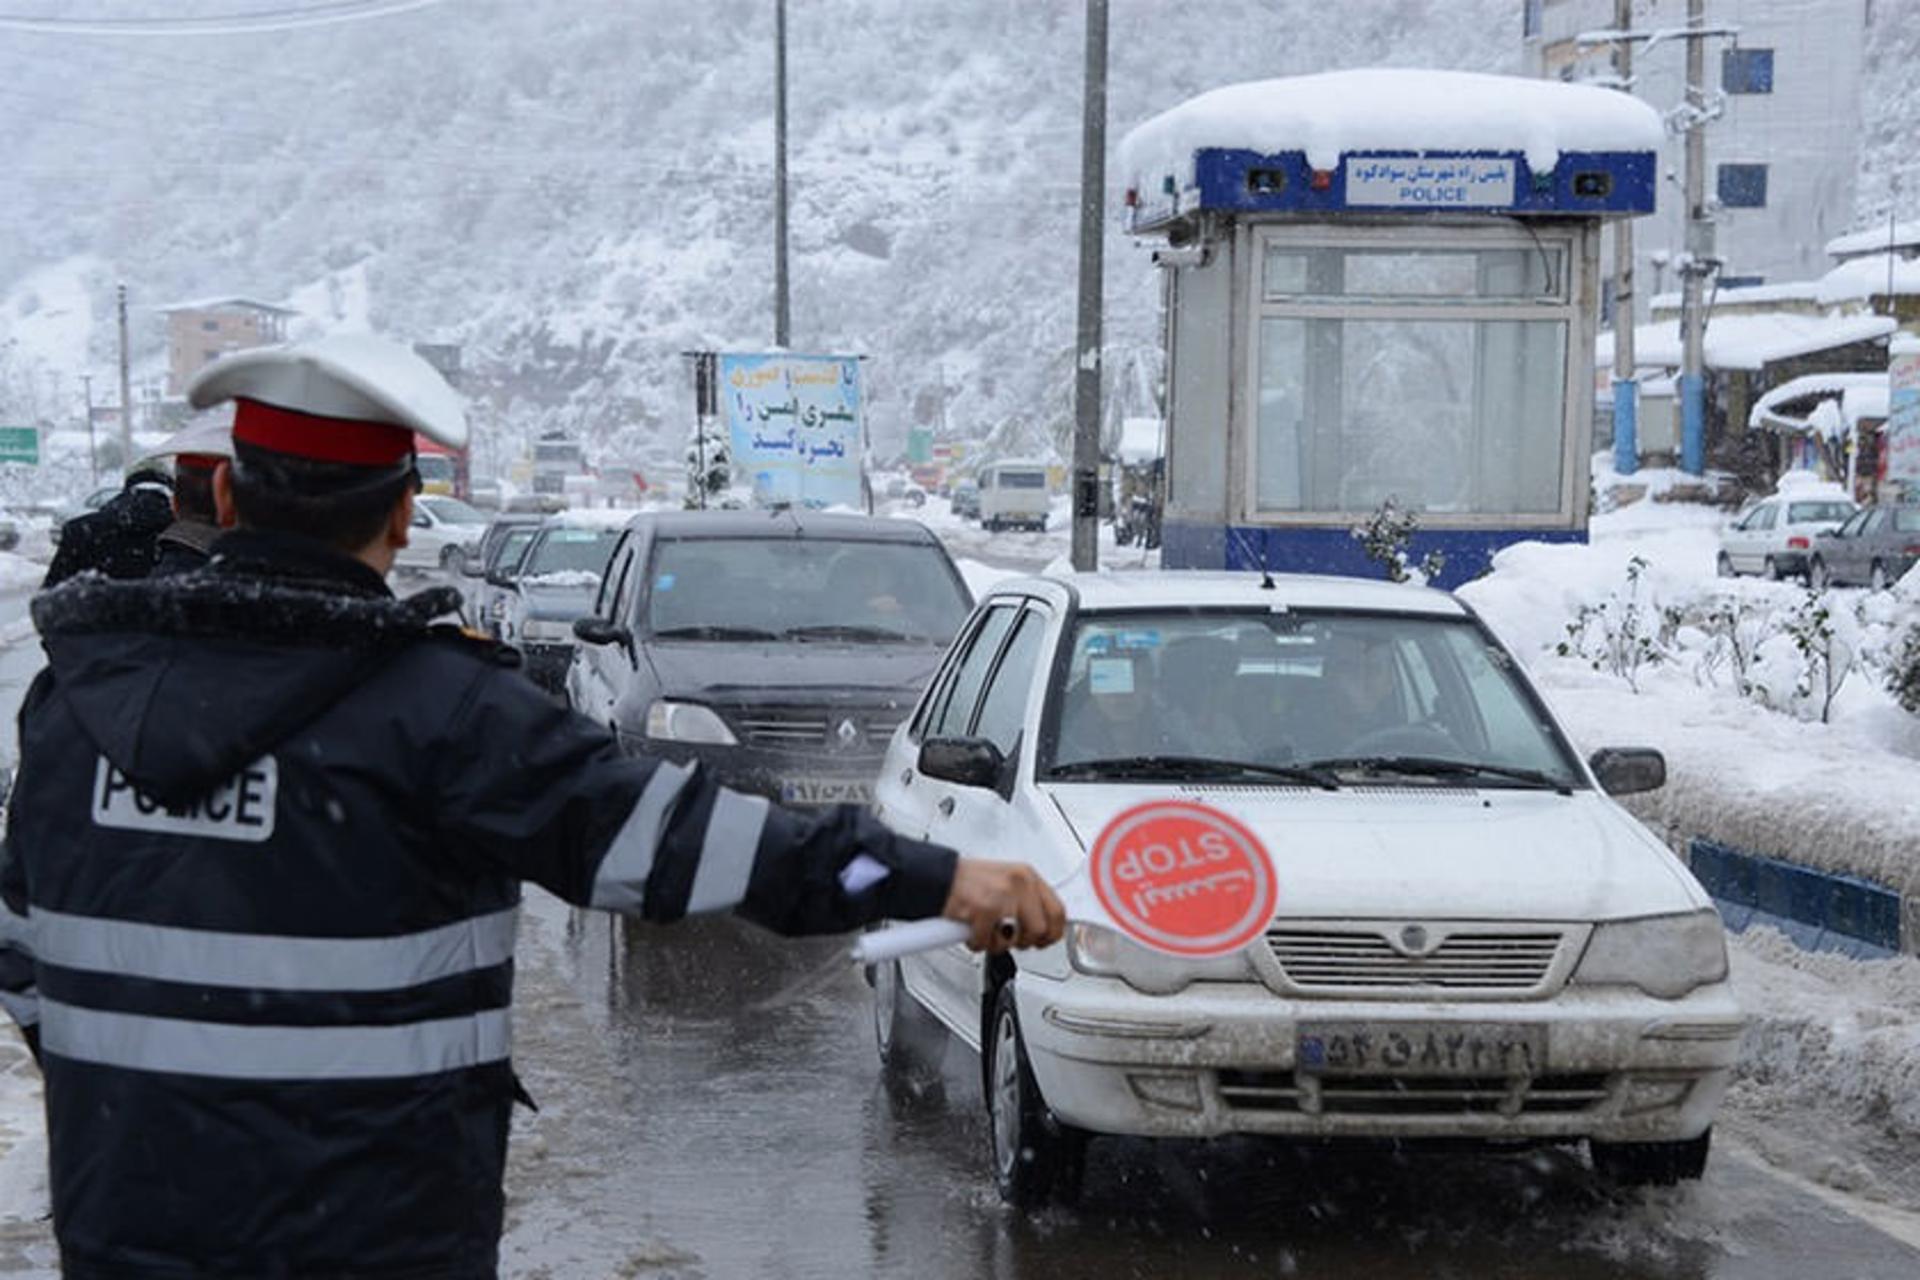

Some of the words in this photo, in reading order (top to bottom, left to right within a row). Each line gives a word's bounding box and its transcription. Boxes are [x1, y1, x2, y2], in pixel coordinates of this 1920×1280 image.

[1458, 165, 1476, 183] راه
[1479, 164, 1507, 184] پلیس
[1399, 186, 1468, 202] POLICE
[101, 765, 267, 827] POCE
[1116, 831, 1231, 881] STOP
[1133, 868, 1251, 919] ایست
